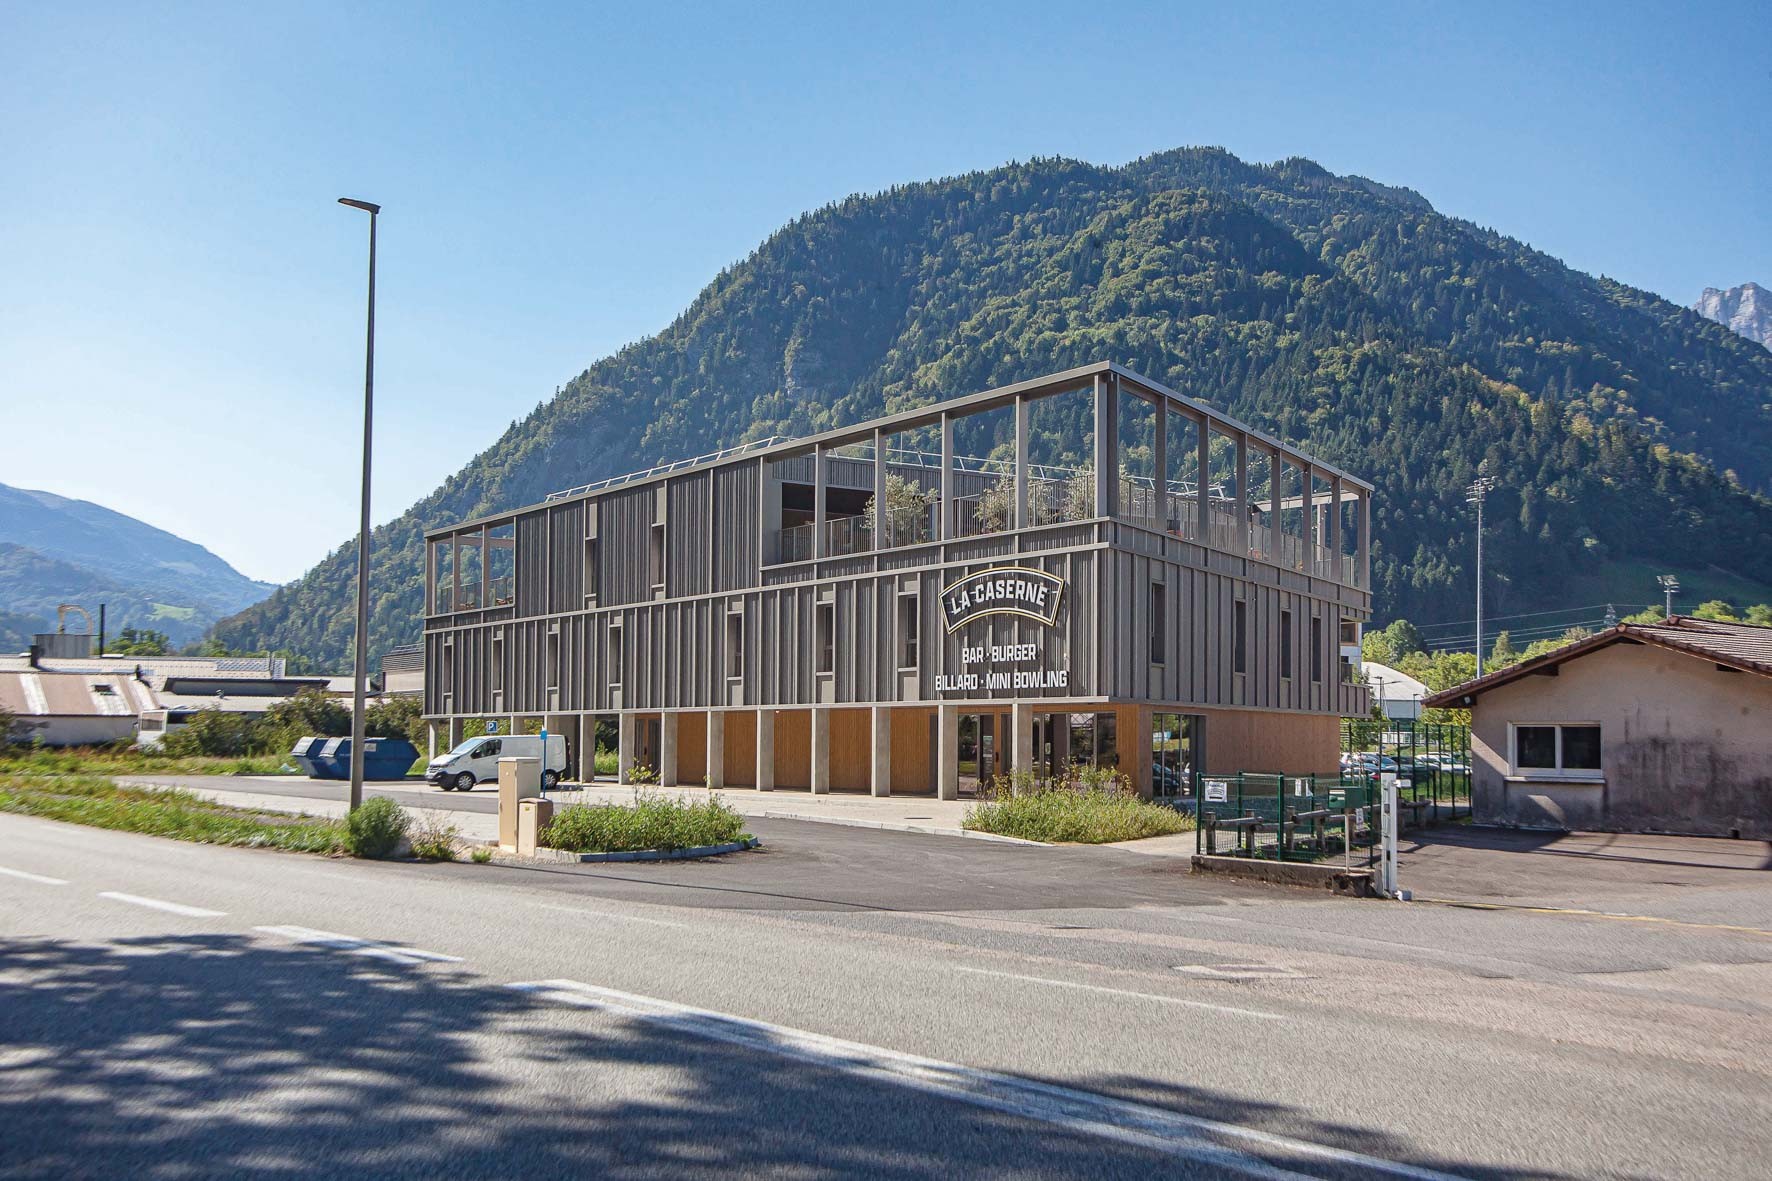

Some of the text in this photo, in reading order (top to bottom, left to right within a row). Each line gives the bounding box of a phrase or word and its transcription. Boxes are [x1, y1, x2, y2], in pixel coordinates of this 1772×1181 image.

[951, 579, 1049, 615] LA CASERNE
[962, 643, 1037, 664] BAR BURGER
[935, 670, 1068, 691] BILLARD MINI BOWLING
